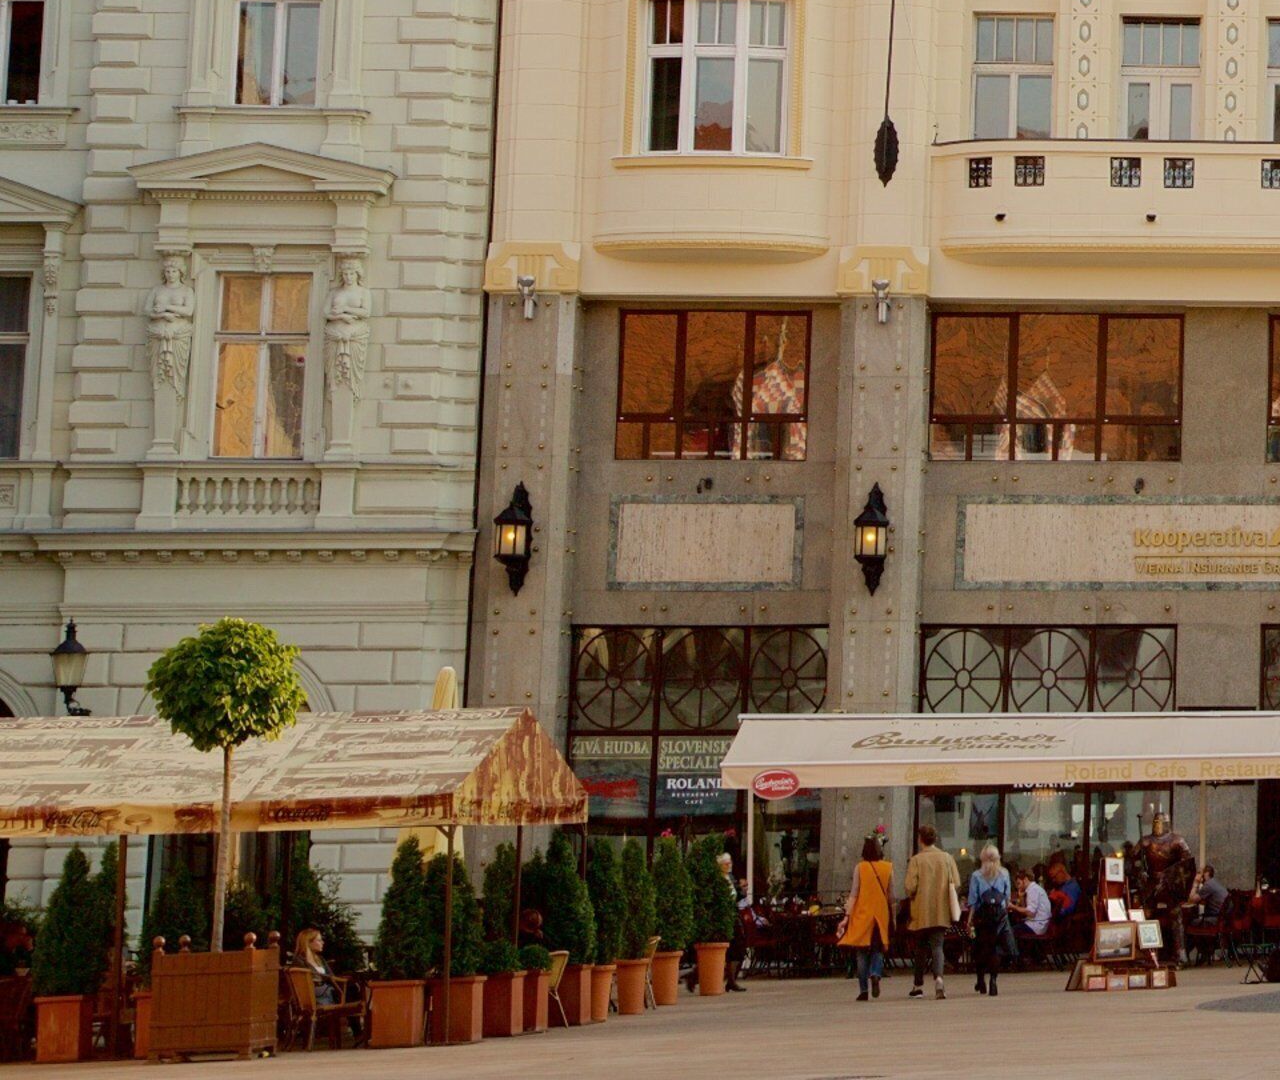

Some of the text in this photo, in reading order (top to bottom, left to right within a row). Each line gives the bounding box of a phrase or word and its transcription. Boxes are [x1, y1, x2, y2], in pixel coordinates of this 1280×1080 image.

[1135, 525, 1268, 552] Kooperativa
[1135, 559, 1182, 575] VIENNA
[1188, 559, 1259, 575] INSURANCE
[604, 740, 650, 754] HUDBA
[661, 740, 731, 754] SLOVENSK
[658, 752, 723, 769] ŠPECIALI
[1064, 762, 1133, 780] Roland
[1146, 762, 1188, 778] Cafe
